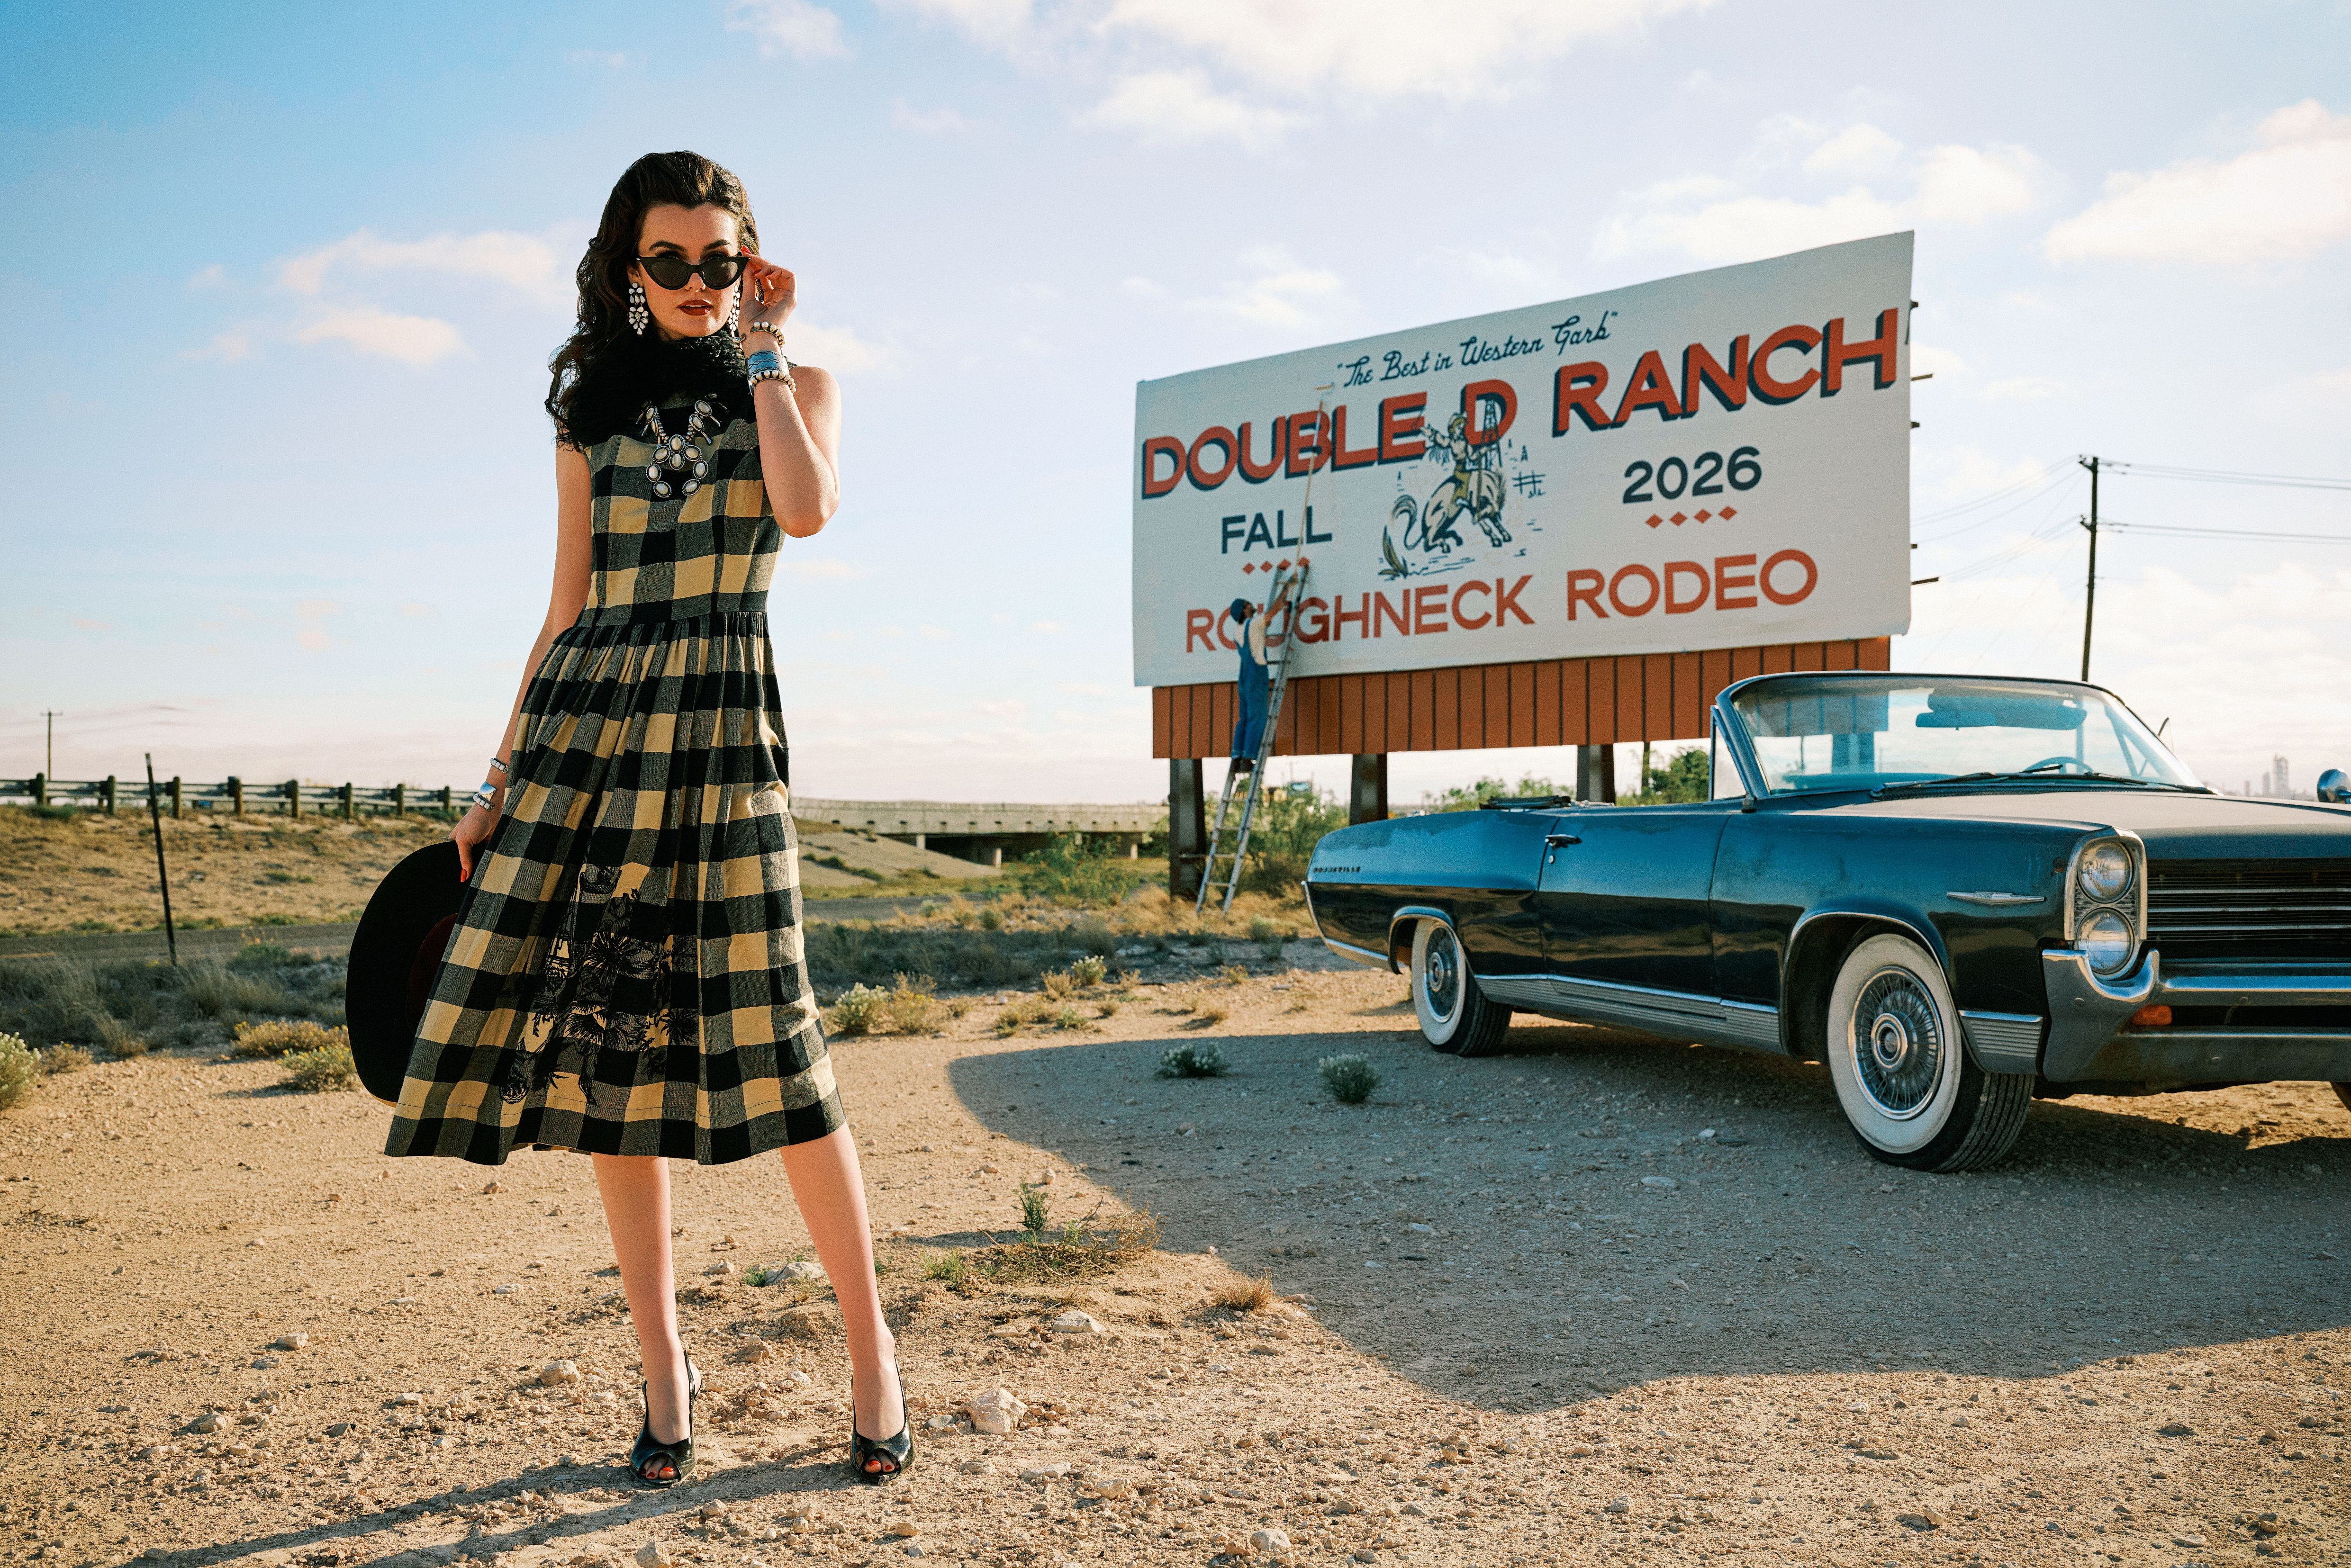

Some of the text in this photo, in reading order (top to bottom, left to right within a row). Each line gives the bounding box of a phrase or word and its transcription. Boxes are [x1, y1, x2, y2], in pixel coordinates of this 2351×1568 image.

[1141, 307, 1899, 500] DOUBLE D RANCH
[1337, 356, 1374, 387] "The
[1379, 350, 1430, 381] Best
[1434, 353, 1454, 372] in
[1459, 335, 1545, 366] Western
[1221, 445, 1763, 554] FALL 2026
[1566, 548, 1818, 621] RODEO
